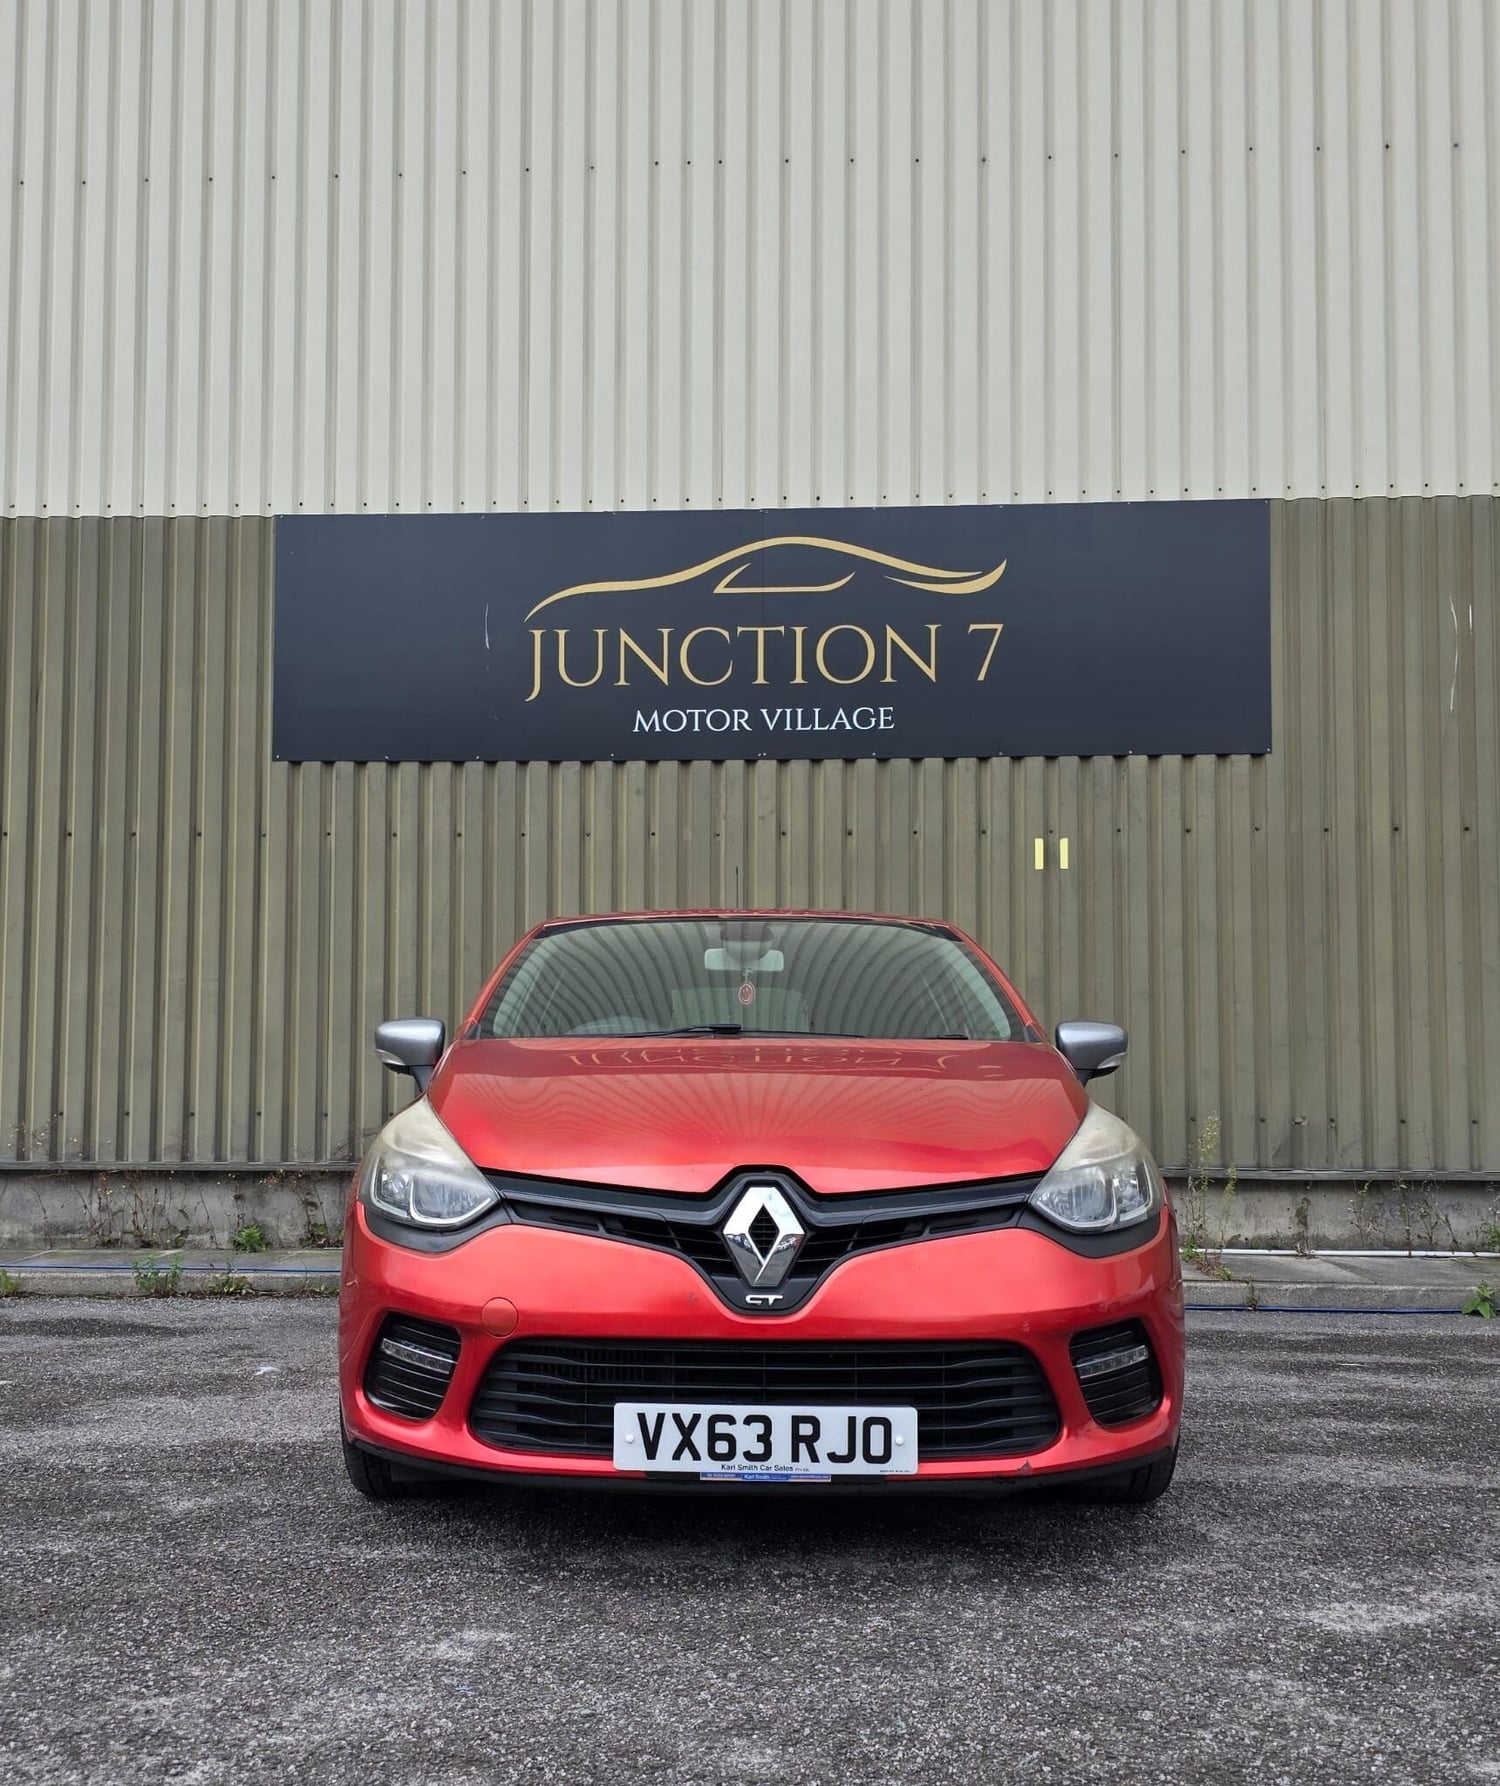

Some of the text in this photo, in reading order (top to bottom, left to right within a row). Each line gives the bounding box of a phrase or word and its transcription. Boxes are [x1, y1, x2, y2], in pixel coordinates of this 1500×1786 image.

[525, 623, 1004, 702] JUNCTION 7
[632, 706, 895, 733] MOTOR VILLAGE
[637, 1412, 892, 1465] VX63 RJO
[721, 1463, 736, 1471] Karl
